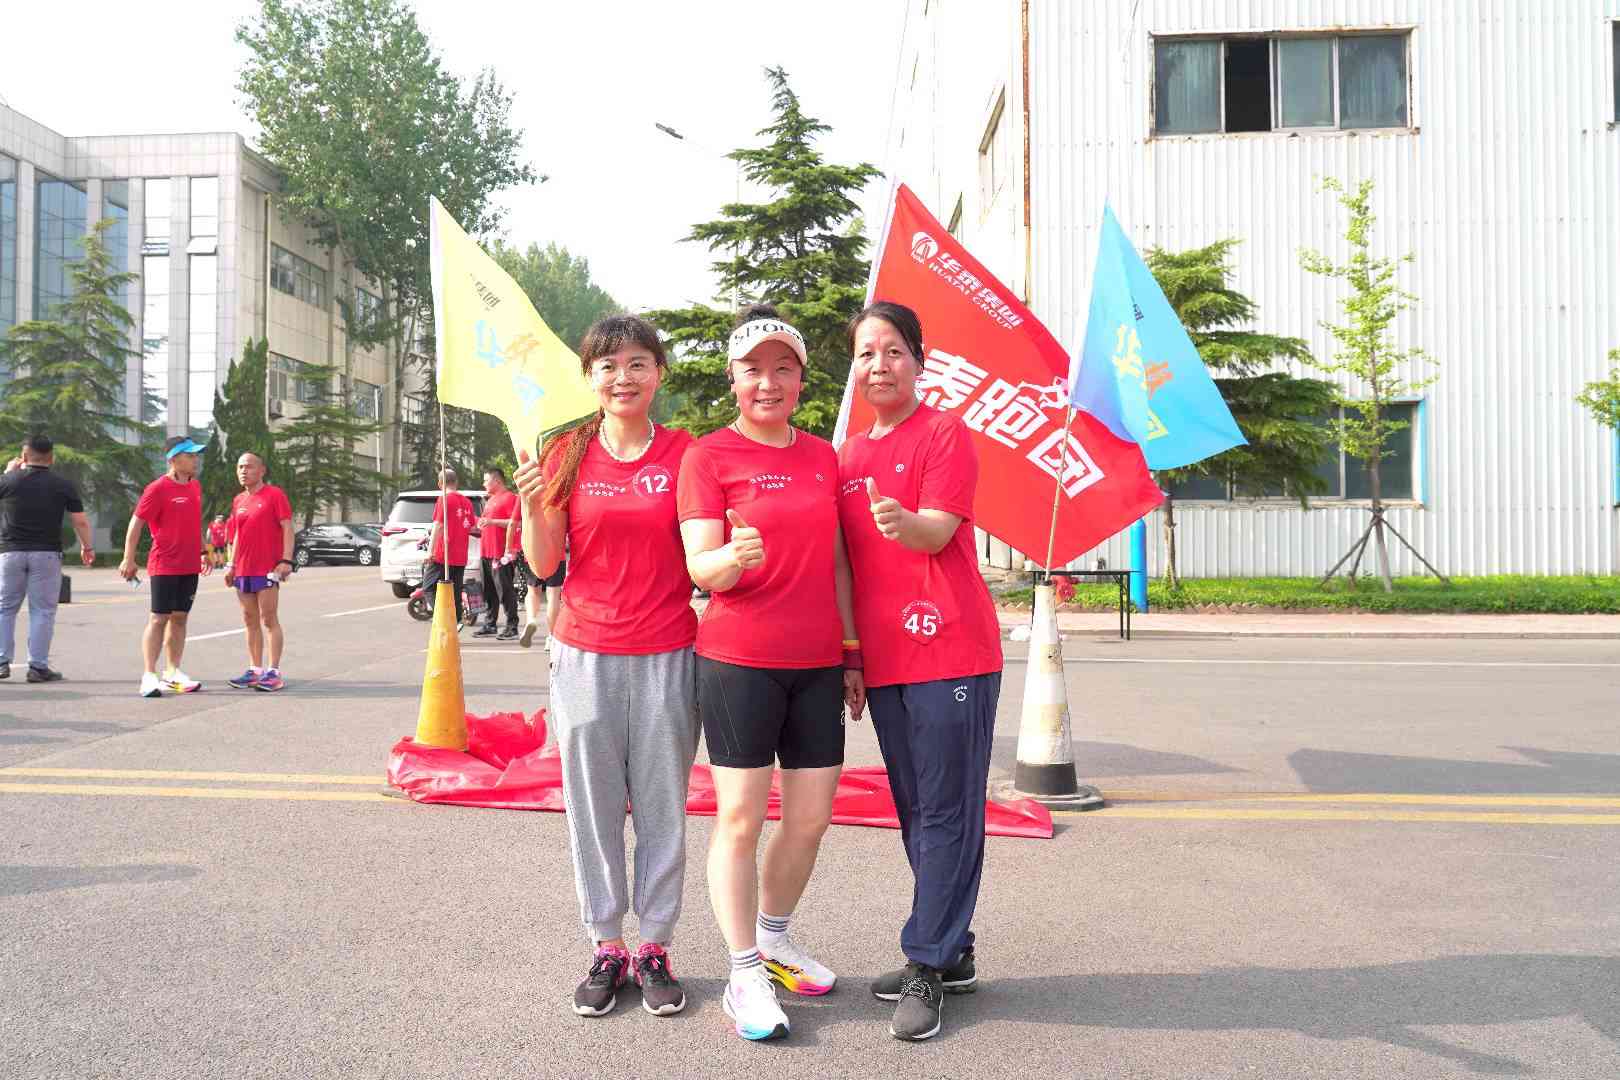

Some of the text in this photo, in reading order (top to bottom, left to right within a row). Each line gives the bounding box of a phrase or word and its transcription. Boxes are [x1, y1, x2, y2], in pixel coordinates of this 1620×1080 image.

[928, 262, 1014, 330] HUATAI GROUP
[640, 474, 670, 494] 12
[904, 613, 937, 636] 45
